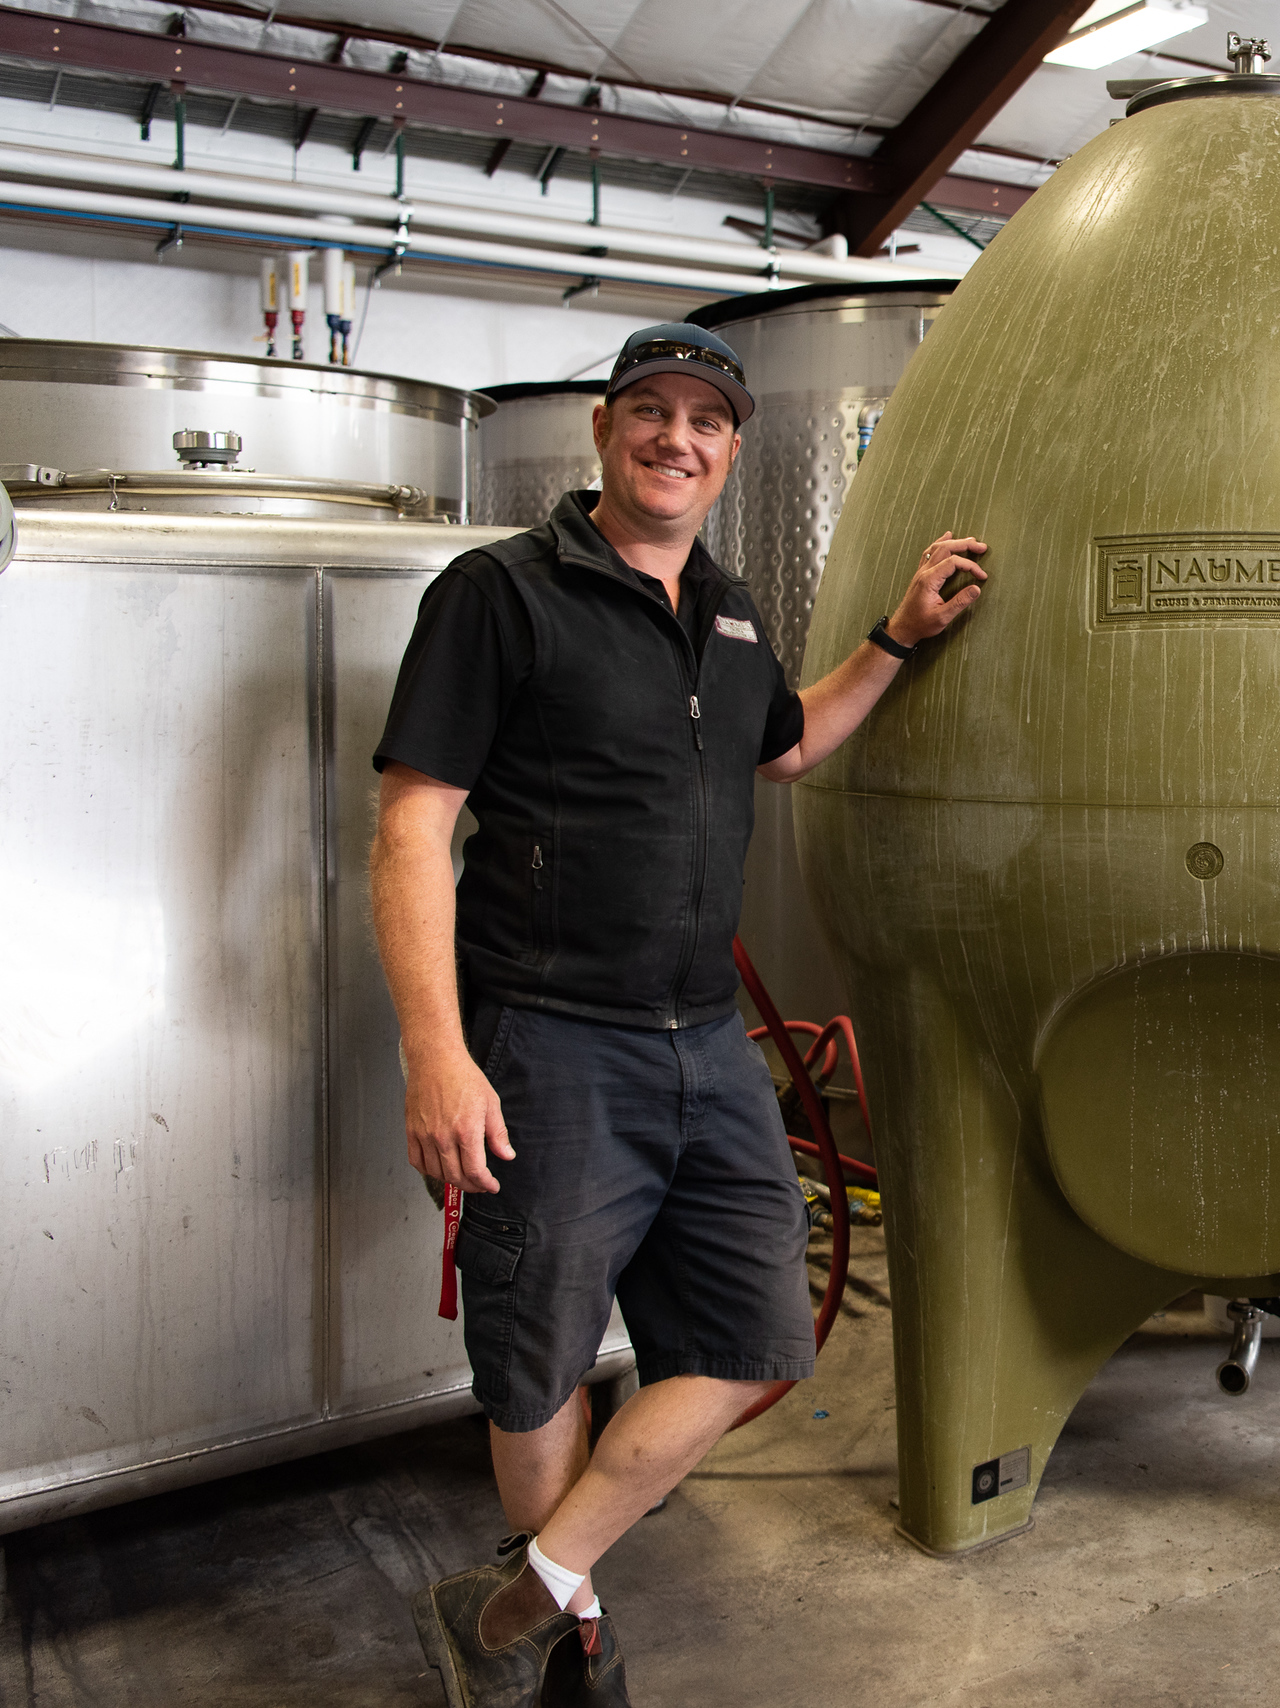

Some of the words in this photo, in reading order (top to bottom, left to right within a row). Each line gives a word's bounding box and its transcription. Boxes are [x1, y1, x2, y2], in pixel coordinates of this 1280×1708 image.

[1154, 597, 1188, 607] CRUSH
[1192, 597, 1200, 606] &
[1202, 597, 1280, 607] FERMENTATION
